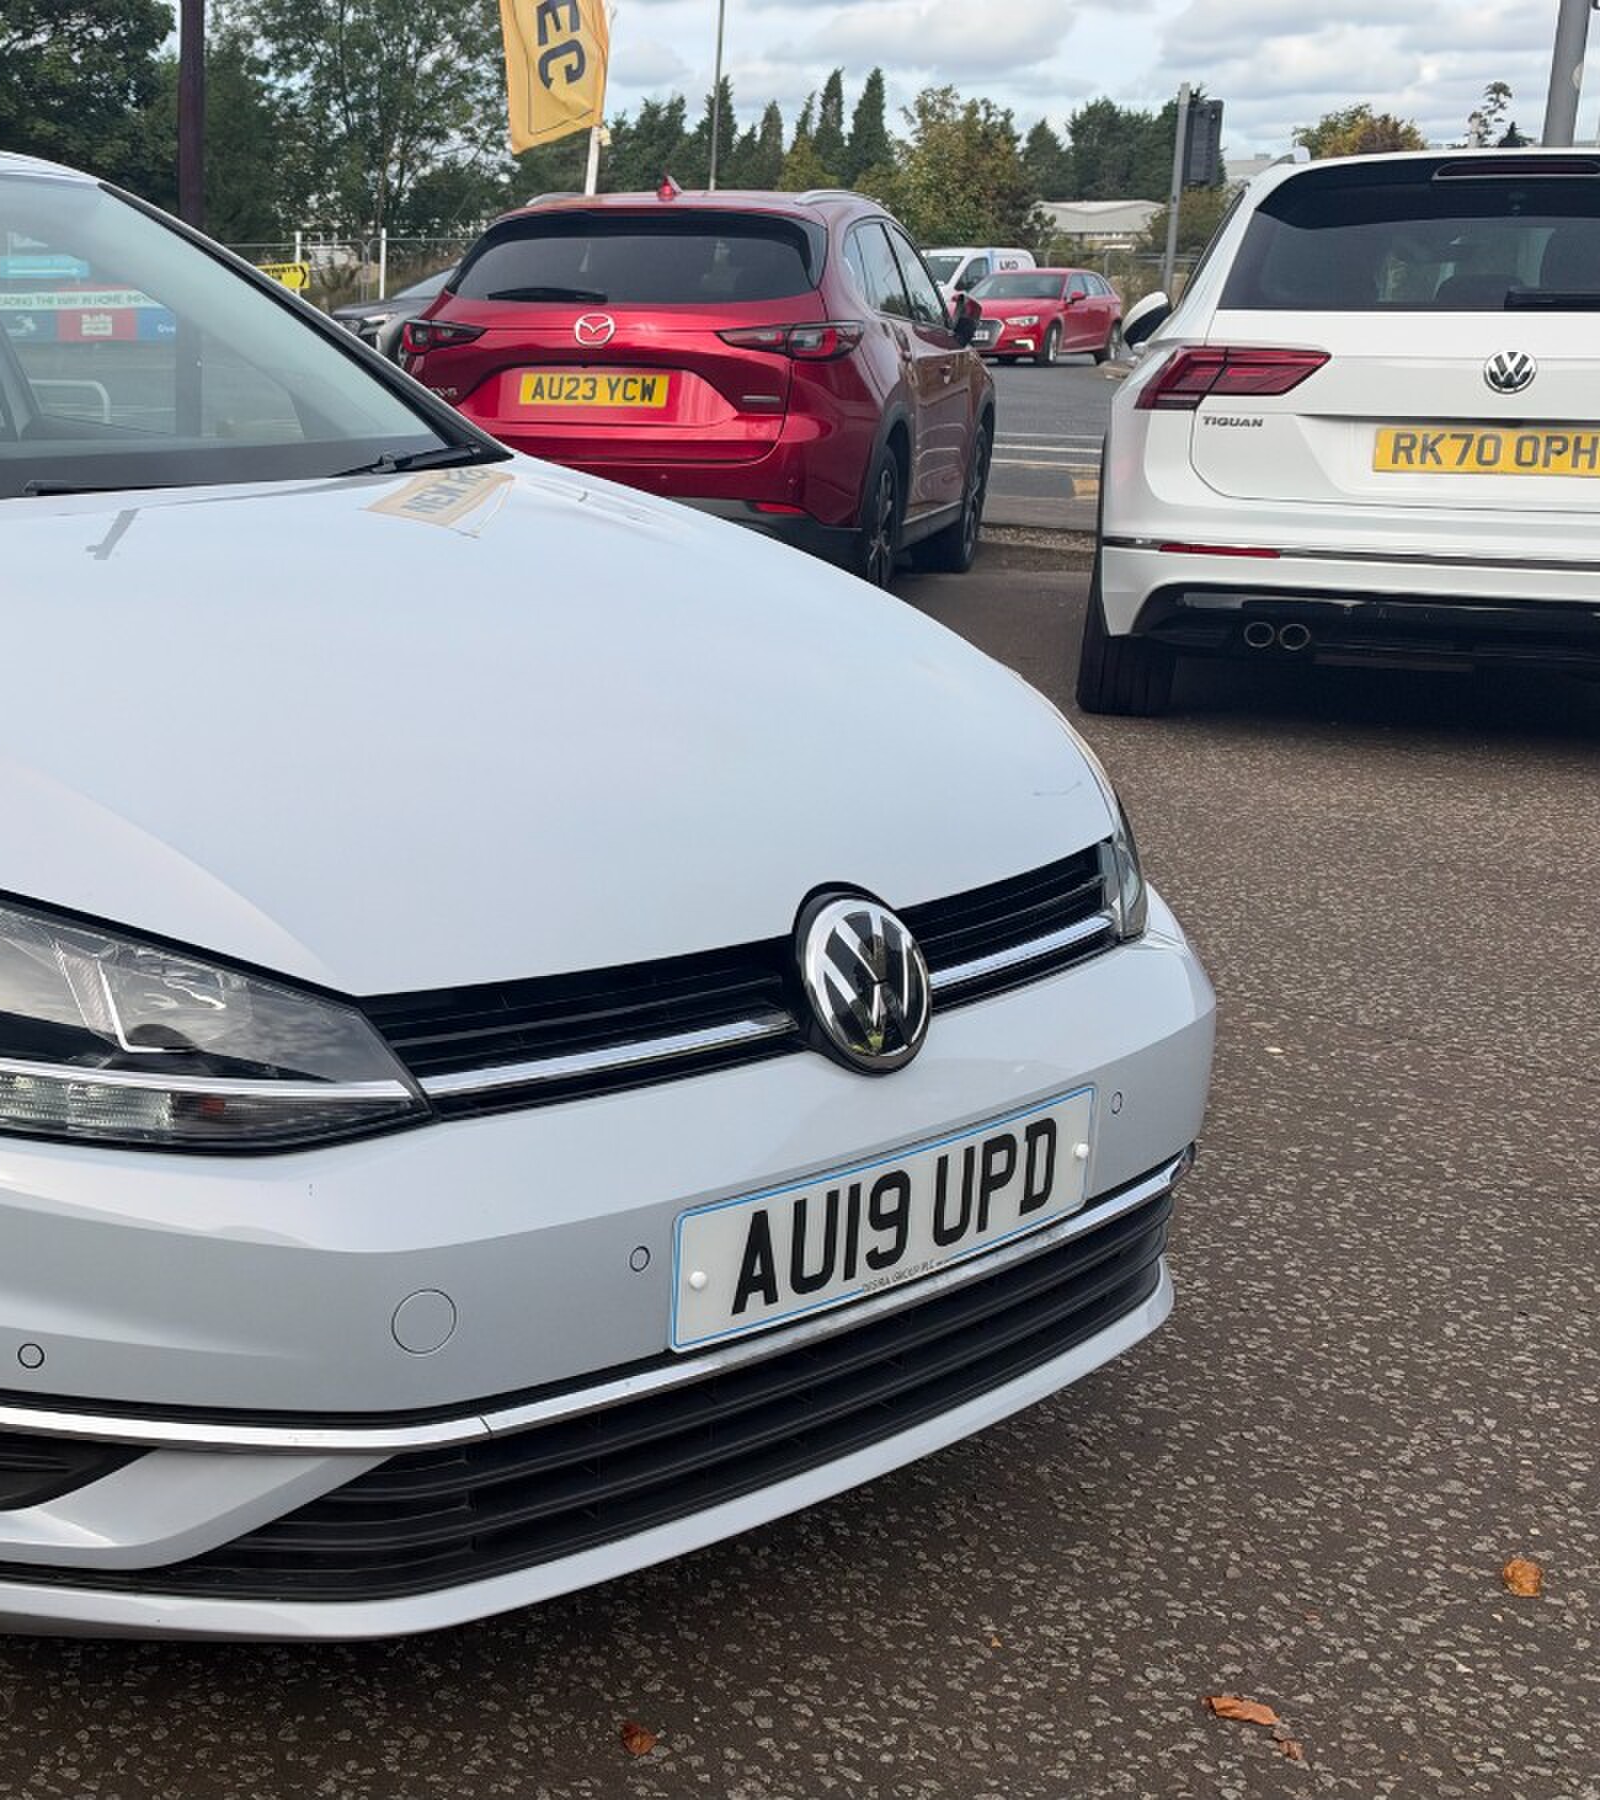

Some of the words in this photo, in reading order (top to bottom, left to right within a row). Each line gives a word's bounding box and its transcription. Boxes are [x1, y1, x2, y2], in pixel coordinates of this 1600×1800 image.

[531, 376, 598, 401] AU23
[606, 377, 657, 402] YCW
[1203, 415, 1264, 428] TIGUAN
[1391, 432, 1503, 467] RK70
[1514, 434, 1600, 469] OPH
[731, 1169, 911, 1316] AU19
[932, 1117, 1058, 1247] UPD
